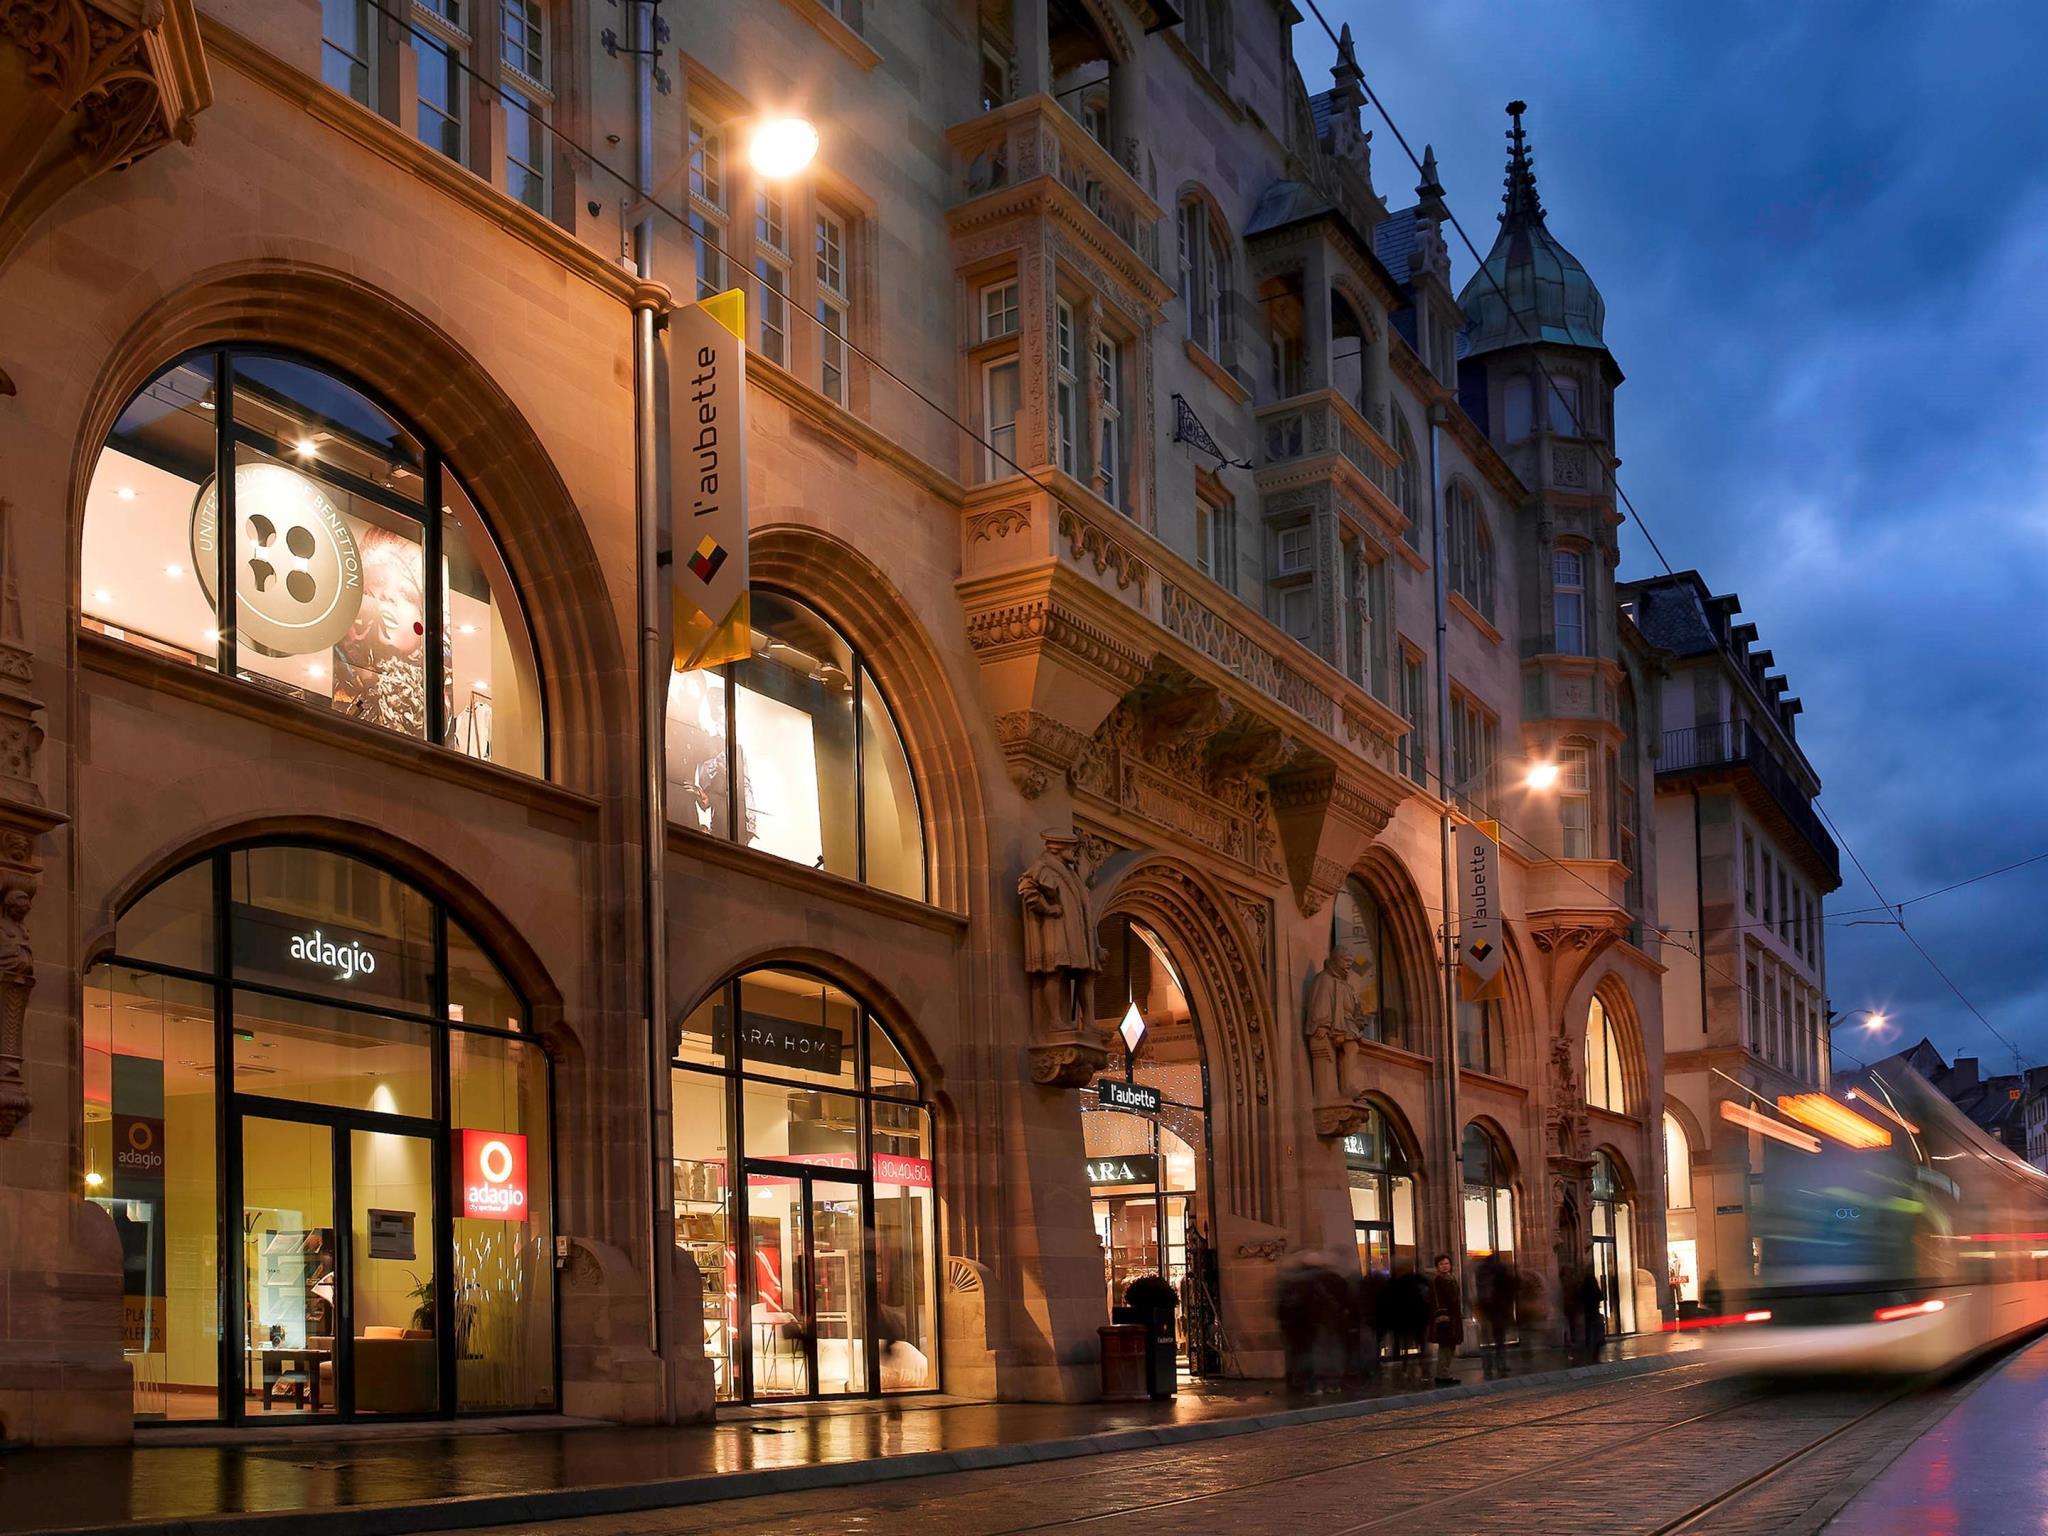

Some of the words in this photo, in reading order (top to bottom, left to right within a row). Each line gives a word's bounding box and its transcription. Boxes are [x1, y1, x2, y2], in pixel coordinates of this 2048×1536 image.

[691, 346, 719, 517] l'aubette
[1470, 845, 1487, 929] l'aubette
[290, 929, 375, 979] adagio
[1111, 1083, 1156, 1109] l'aubette
[119, 1148, 162, 1169] adagio
[468, 1181, 524, 1212] adagio
[122, 1322, 161, 1345] KLÉR
